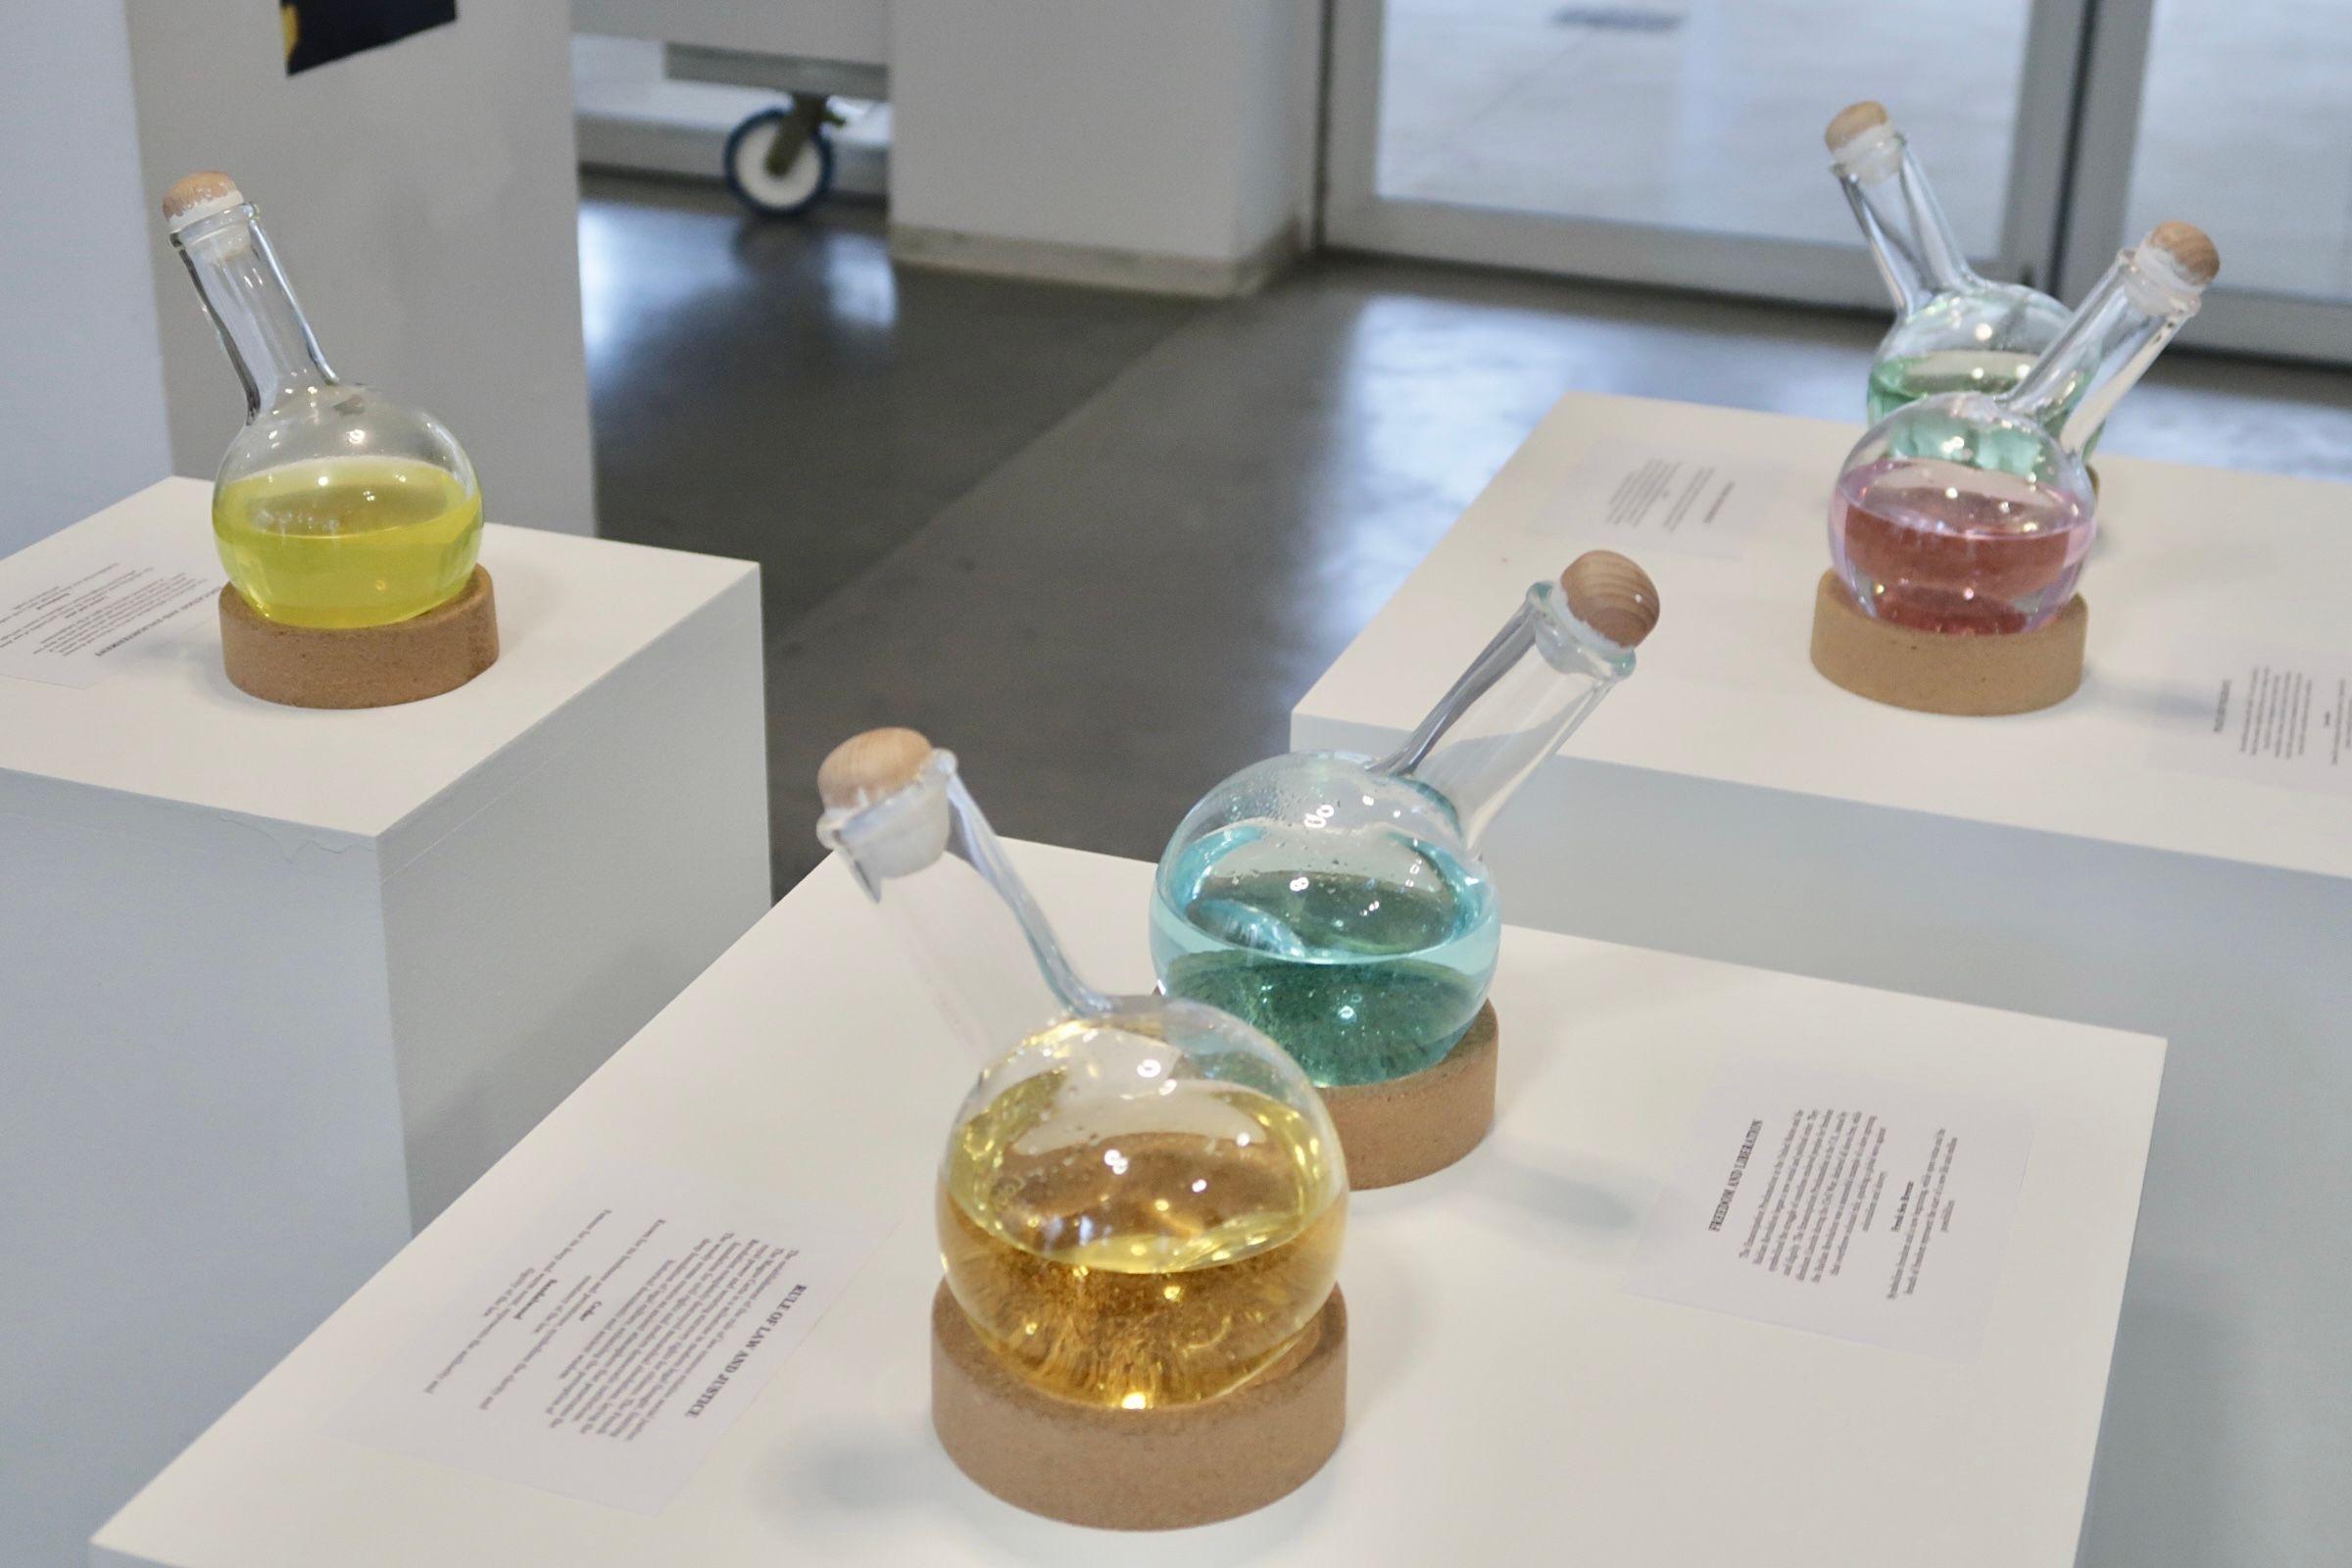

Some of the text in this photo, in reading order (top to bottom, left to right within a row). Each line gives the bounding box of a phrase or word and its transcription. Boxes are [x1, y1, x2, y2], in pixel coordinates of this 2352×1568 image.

[1708, 1189, 1736, 1232] FREEDOM
[1728, 1169, 1742, 1189] AND
[685, 1284, 807, 1417] RULE OF LAW AND JUSTICE
